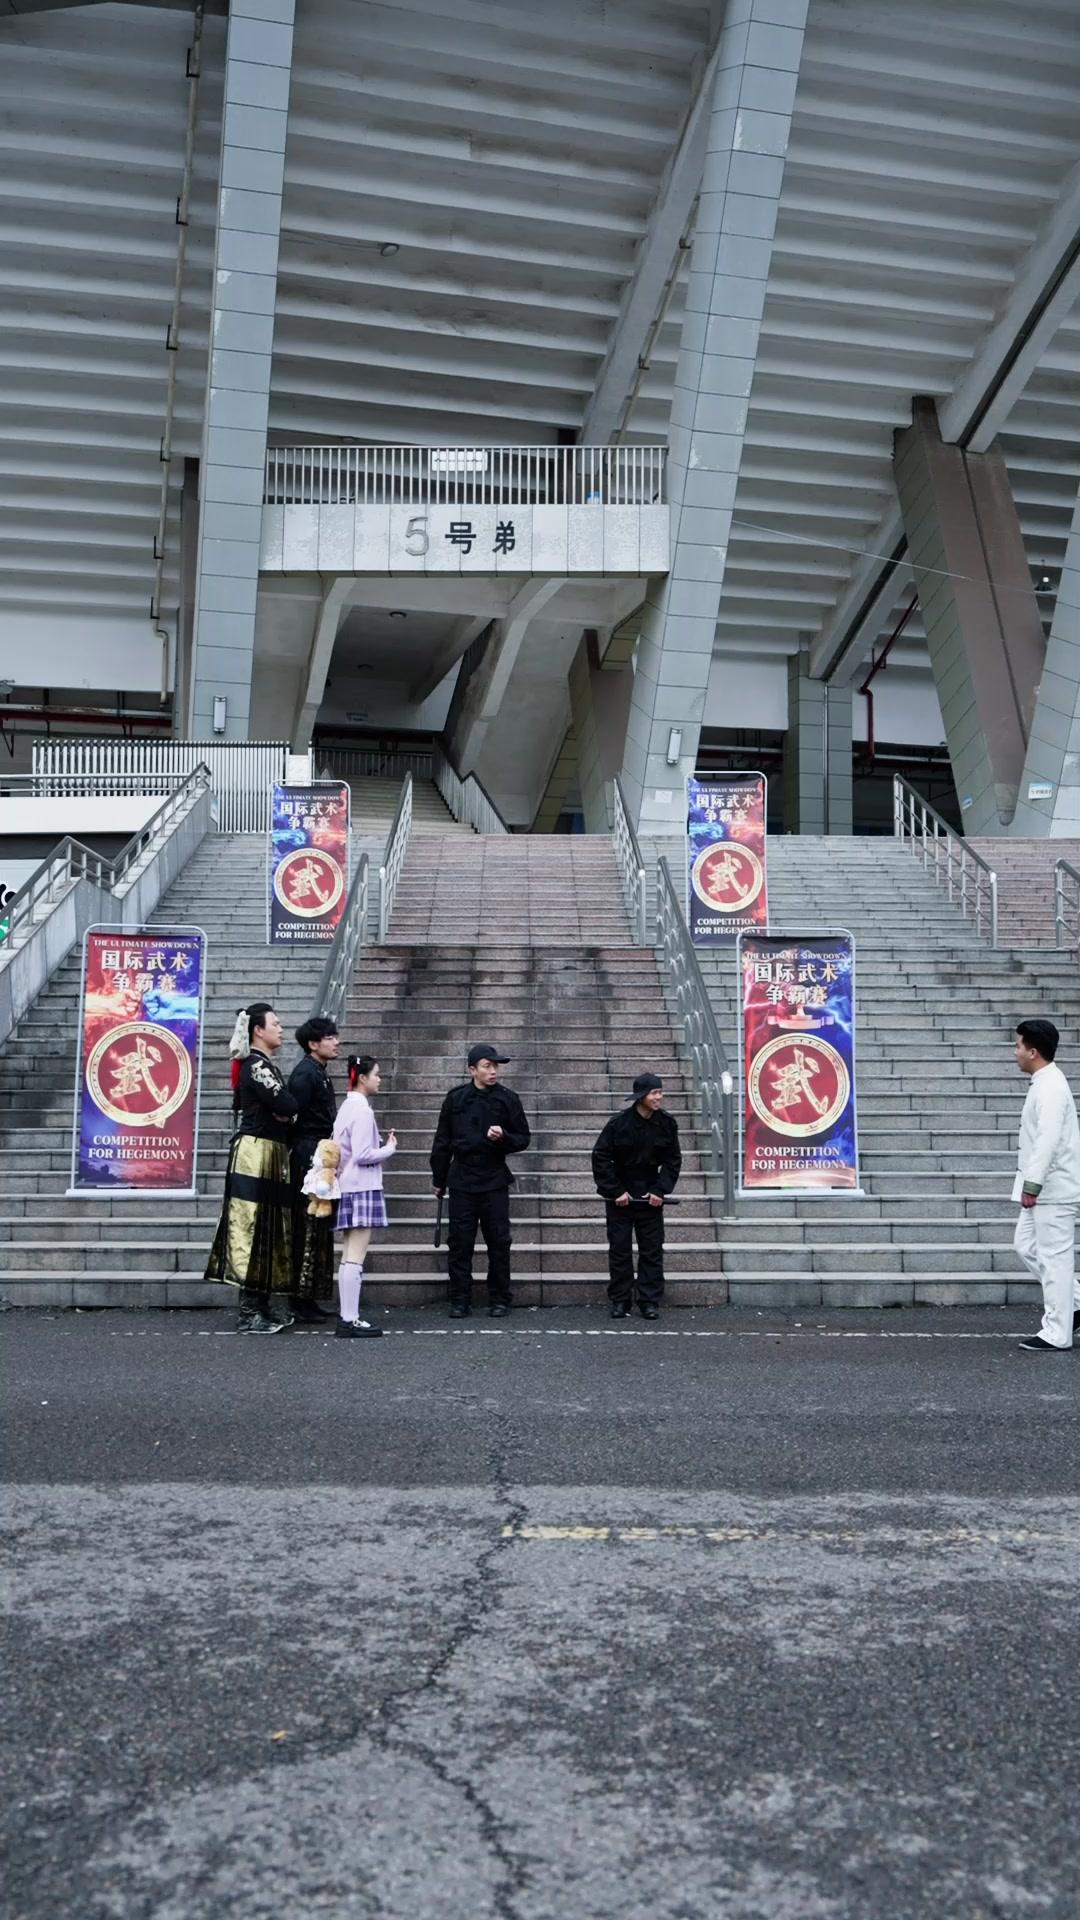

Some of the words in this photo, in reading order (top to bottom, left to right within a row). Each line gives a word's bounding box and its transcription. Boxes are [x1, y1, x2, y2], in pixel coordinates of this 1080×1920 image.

[696, 794, 755, 808] 国际武术
[280, 801, 338, 816] 国际武术
[278, 922, 335, 930] COMPETITION
[294, 931, 335, 939] HEGEMON
[94, 939, 108, 947] THE
[110, 940, 148, 948] ULTIMATE
[151, 941, 200, 949] SHOWDOWN
[101, 950, 189, 971] 国际武术
[754, 962, 839, 983] 国际武术
[112, 972, 177, 993] 争霸赛
[765, 984, 828, 1006] 争霸赛
[93, 1135, 181, 1147] COMPETITION
[88, 1148, 114, 1158] FOR
[116, 1148, 187, 1160] HEGEMONY
[755, 1146, 840, 1157] COMPETITION
[751, 1159, 776, 1170] FOR
[779, 1159, 848, 1170] HEGEMONY
